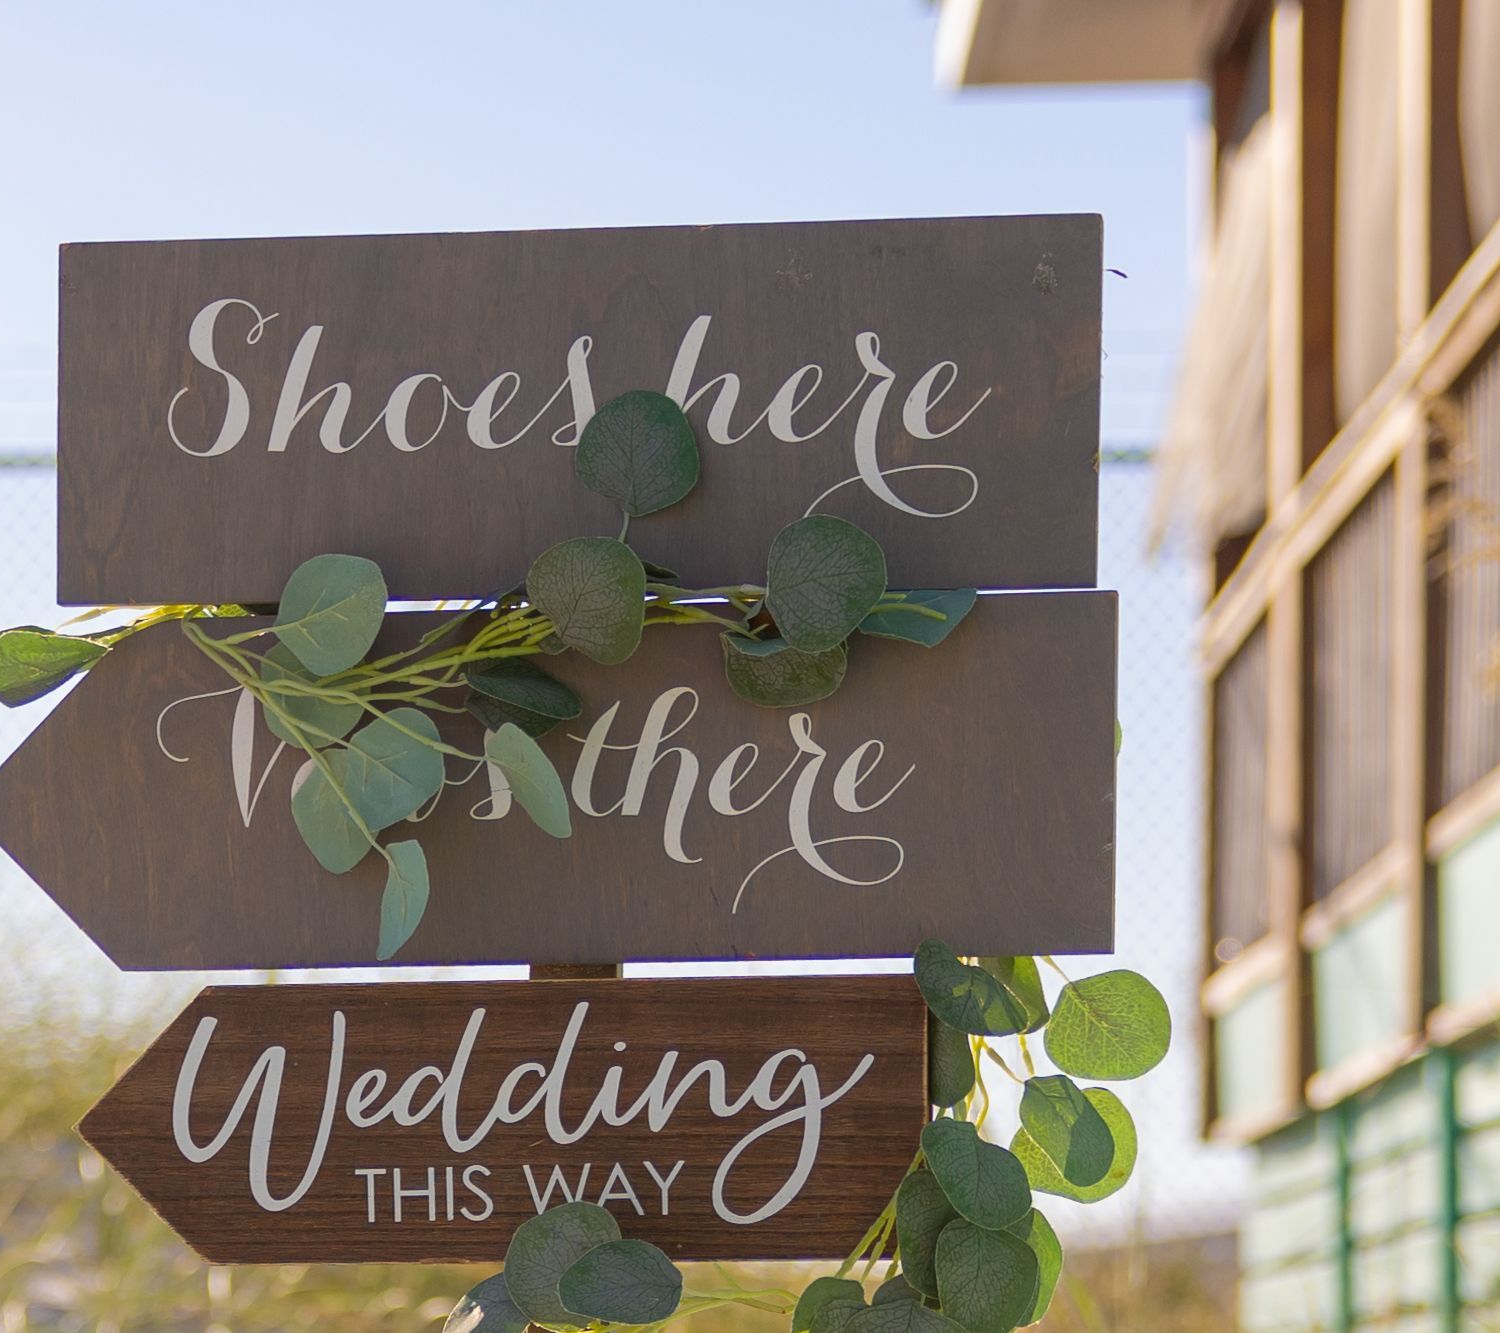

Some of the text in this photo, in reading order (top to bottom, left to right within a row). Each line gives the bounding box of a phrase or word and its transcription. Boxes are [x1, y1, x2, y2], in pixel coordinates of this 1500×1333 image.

[167, 298, 993, 518] Shoes here
[566, 686, 917, 915] there
[172, 1001, 876, 1226] Wedding
[354, 1159, 686, 1223] THIS WAY
